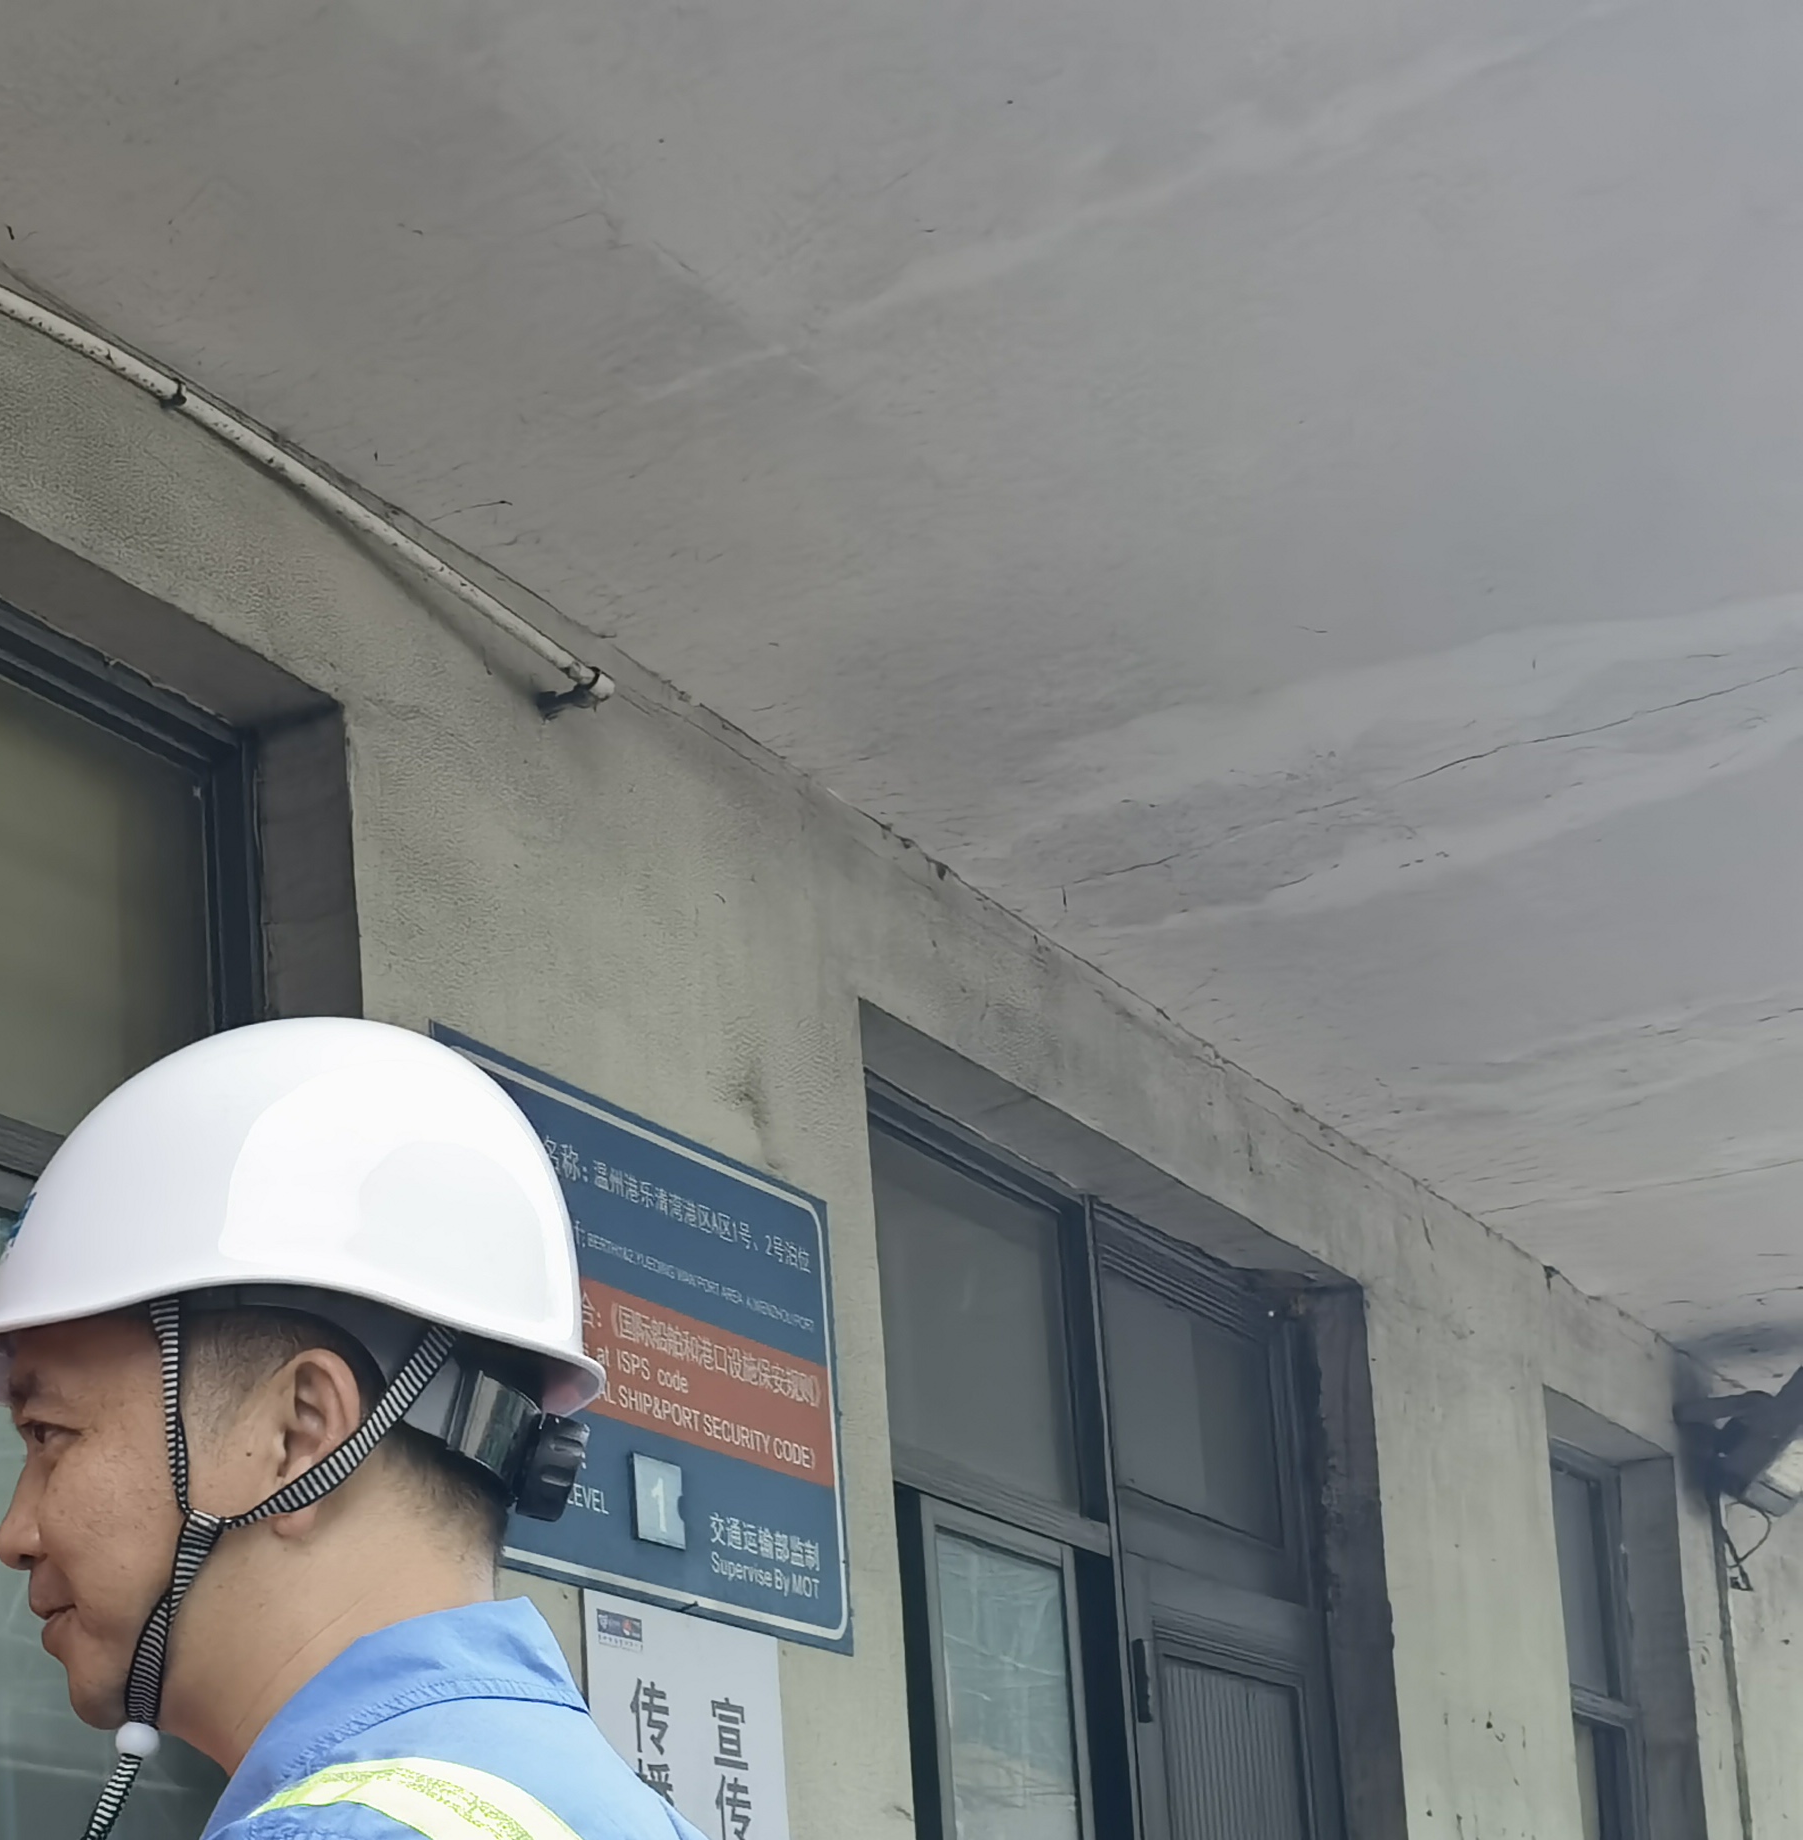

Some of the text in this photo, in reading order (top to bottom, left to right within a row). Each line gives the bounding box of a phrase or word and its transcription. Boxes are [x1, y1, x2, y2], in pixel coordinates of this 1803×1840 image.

[617, 1348, 651, 1381] ISPS
[657, 1368, 689, 1393] code
[618, 1384, 700, 1433] SHIP&PORT
[702, 1413, 772, 1455] SECURITY
[651, 1477, 668, 1533] 1
[709, 1512, 820, 1571] 交通运输部监制
[710, 1550, 820, 1599] Supervise By MOT
